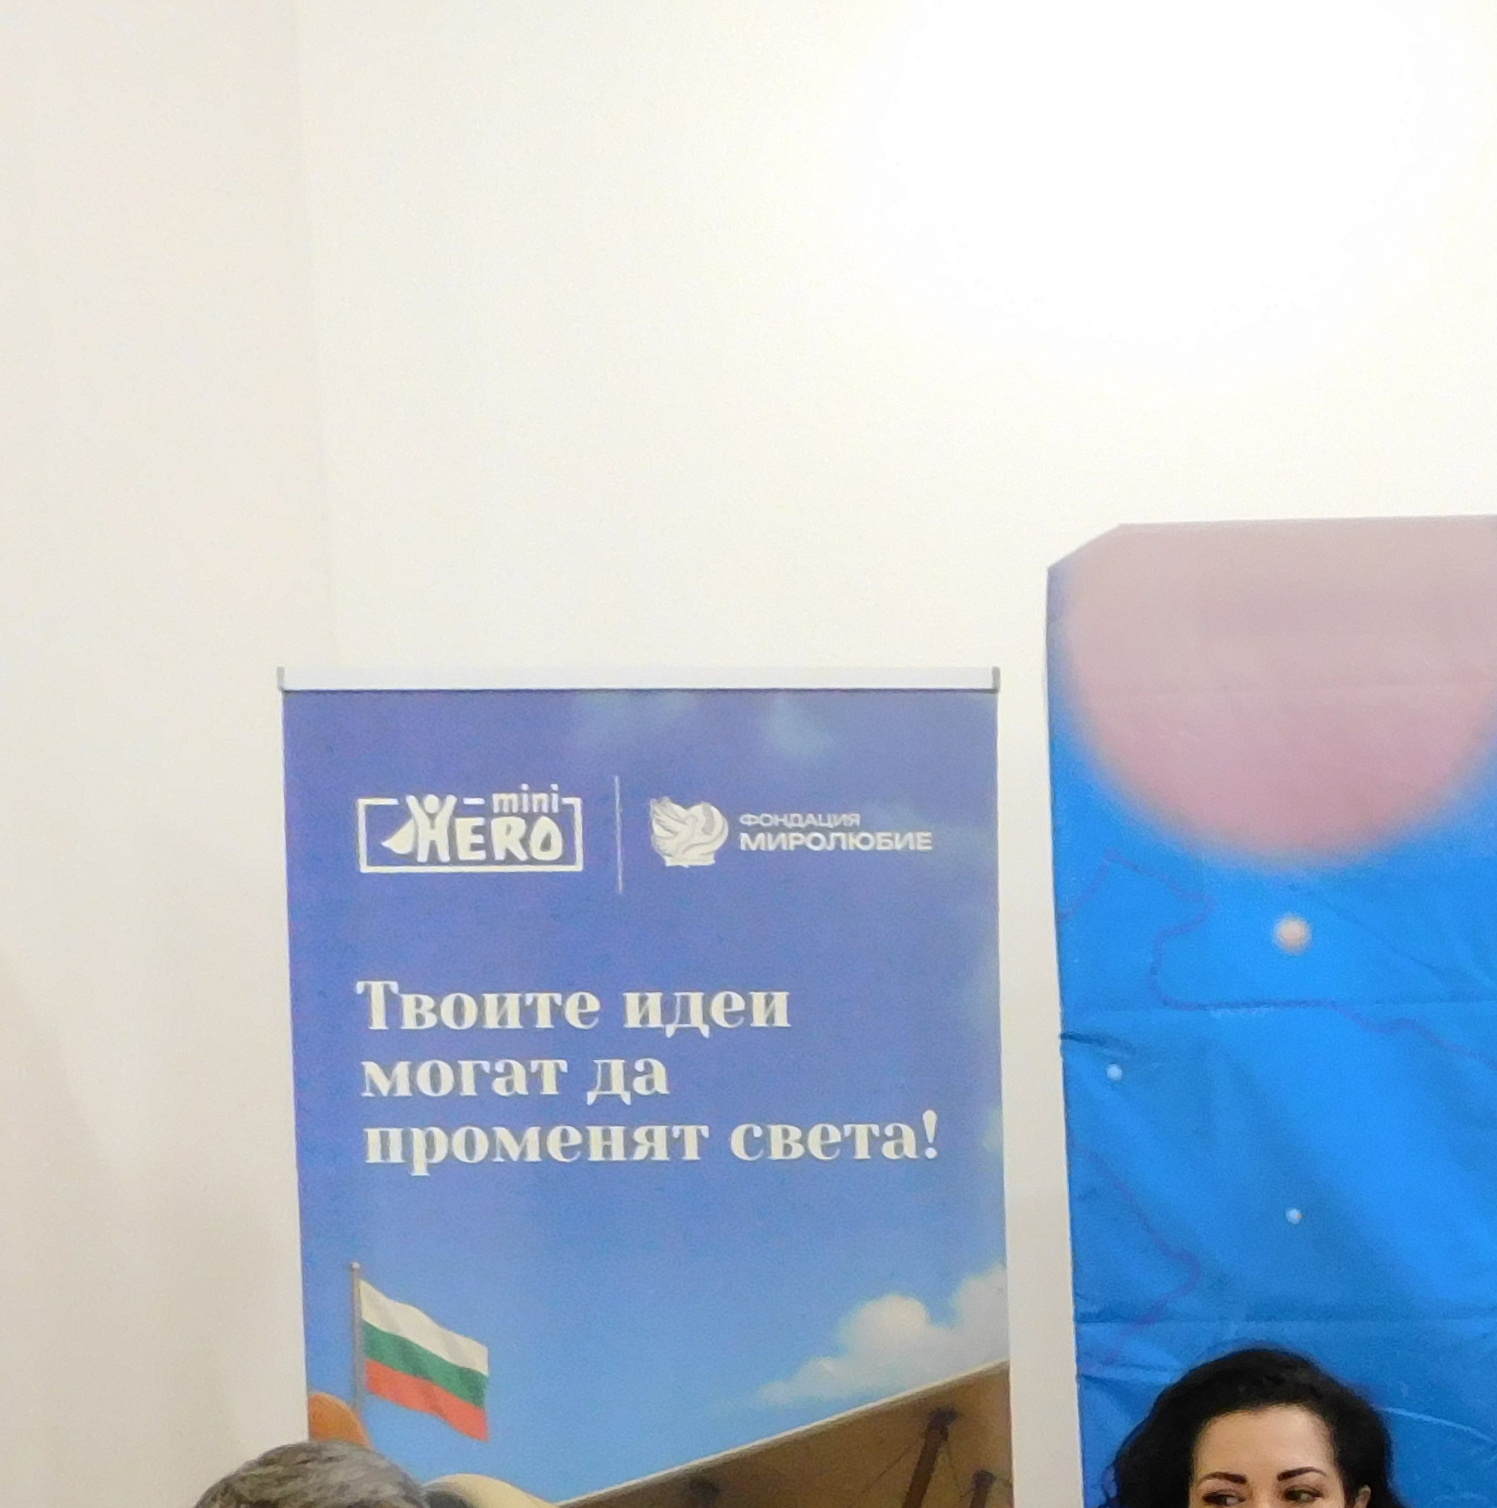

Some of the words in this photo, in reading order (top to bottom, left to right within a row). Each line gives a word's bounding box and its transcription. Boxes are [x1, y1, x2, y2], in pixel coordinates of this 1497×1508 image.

[492, 784, 559, 813] mini
[738, 812, 861, 829] ФОНДАЦИЯ
[406, 794, 564, 862] HERO
[739, 831, 933, 853] МИРОЛЮБИЕ
[356, 980, 600, 1031] Твоите
[623, 989, 791, 1038] идеи
[361, 1057, 567, 1098] могат
[587, 1057, 670, 1106] да
[364, 1123, 710, 1177] променят
[730, 1110, 939, 1161] света!
